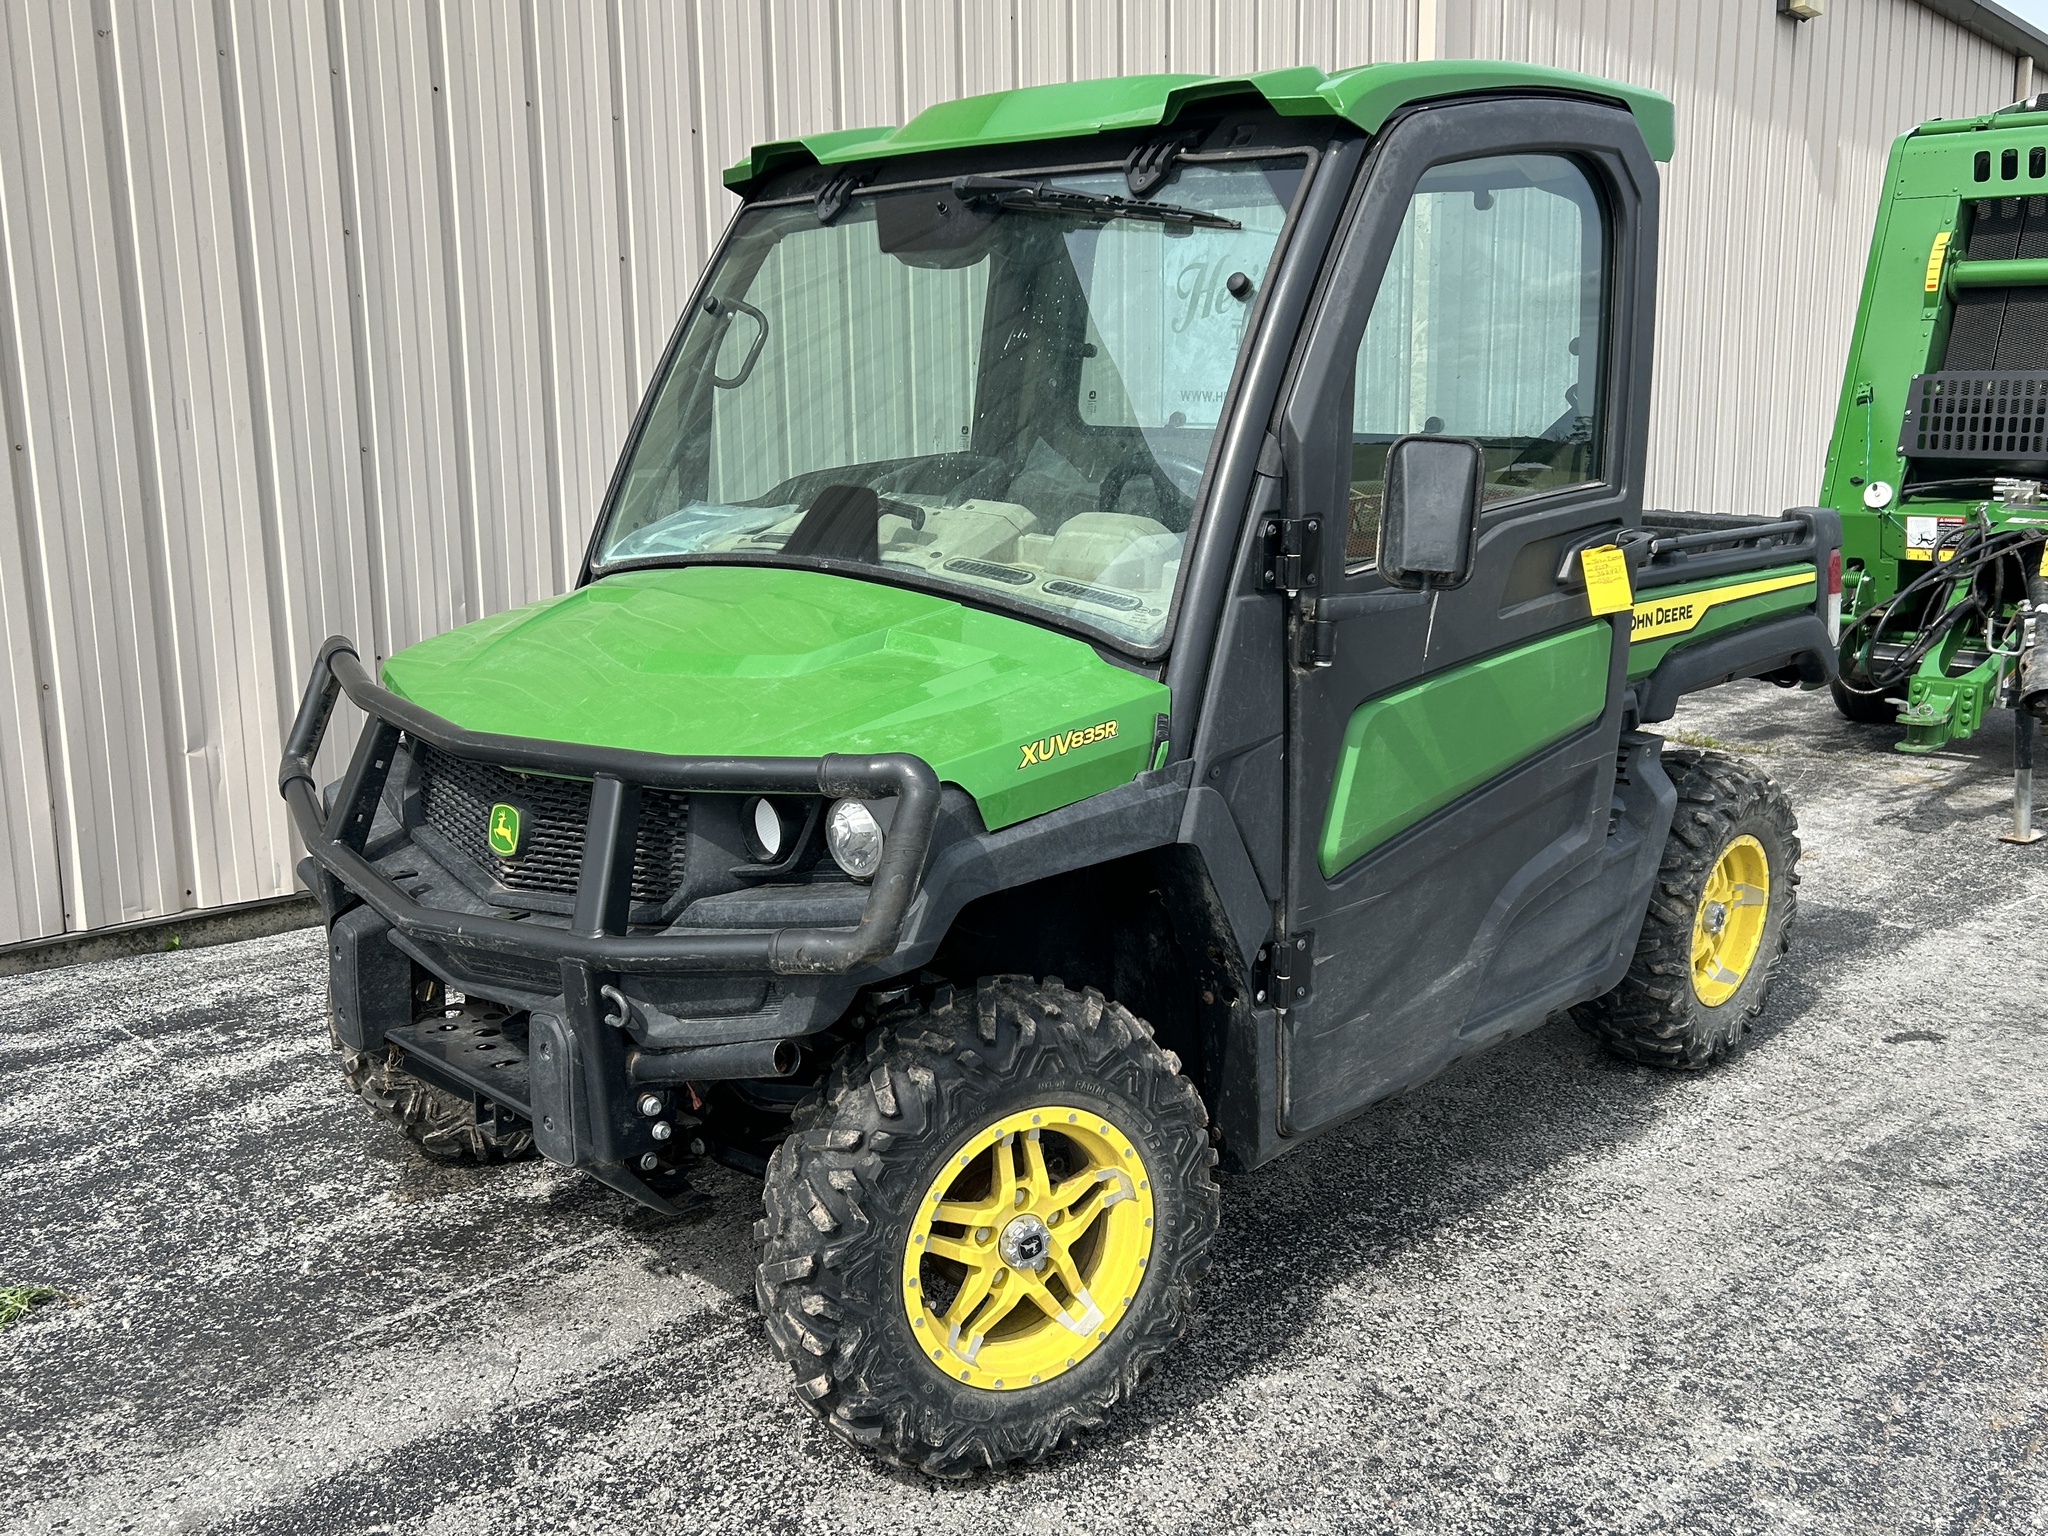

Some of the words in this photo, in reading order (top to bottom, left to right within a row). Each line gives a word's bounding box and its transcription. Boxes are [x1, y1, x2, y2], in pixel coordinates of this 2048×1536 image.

[1631, 612, 1653, 630] OHN
[1656, 604, 1693, 625] DEERE
[1017, 719, 1117, 770] XUV835R
[1074, 1080, 1107, 1096] RADIAL
[878, 1222, 912, 1372] MAXXIS
